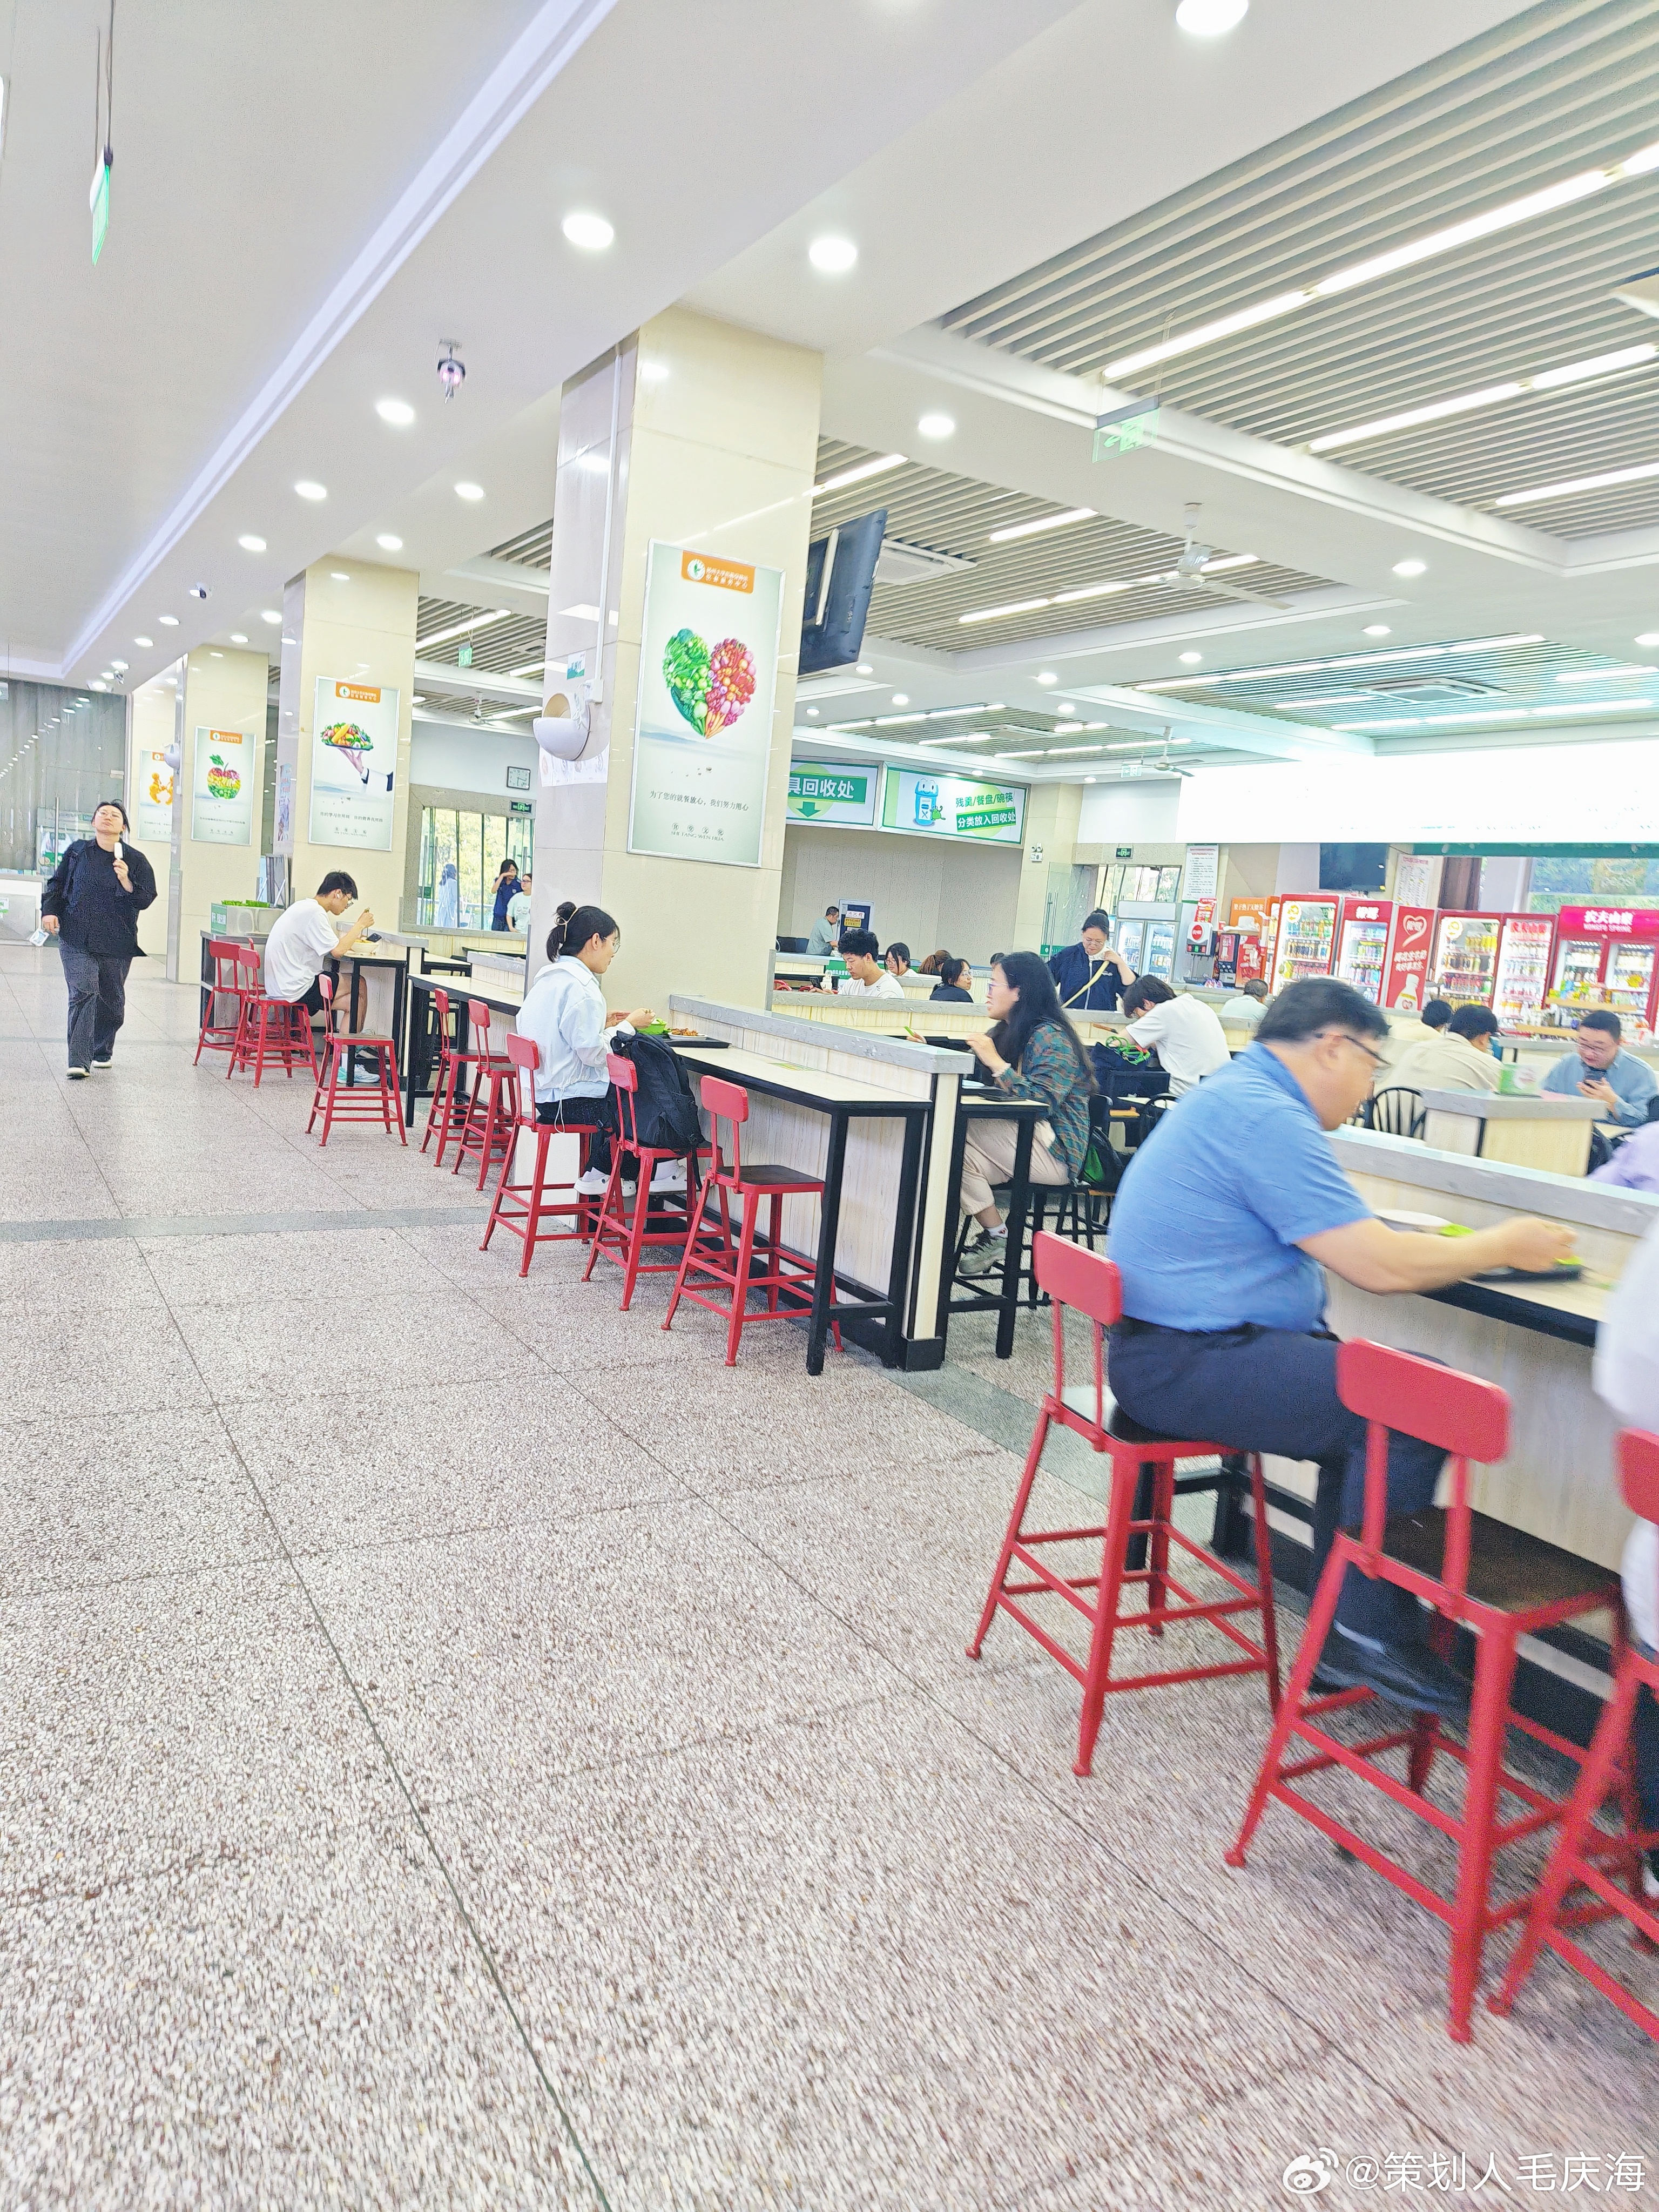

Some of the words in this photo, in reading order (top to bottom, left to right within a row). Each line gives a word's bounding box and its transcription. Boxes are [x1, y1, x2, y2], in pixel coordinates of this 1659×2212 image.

[788, 777, 854, 799] 具回收处
[957, 812, 1016, 828] 分类放入回收处
